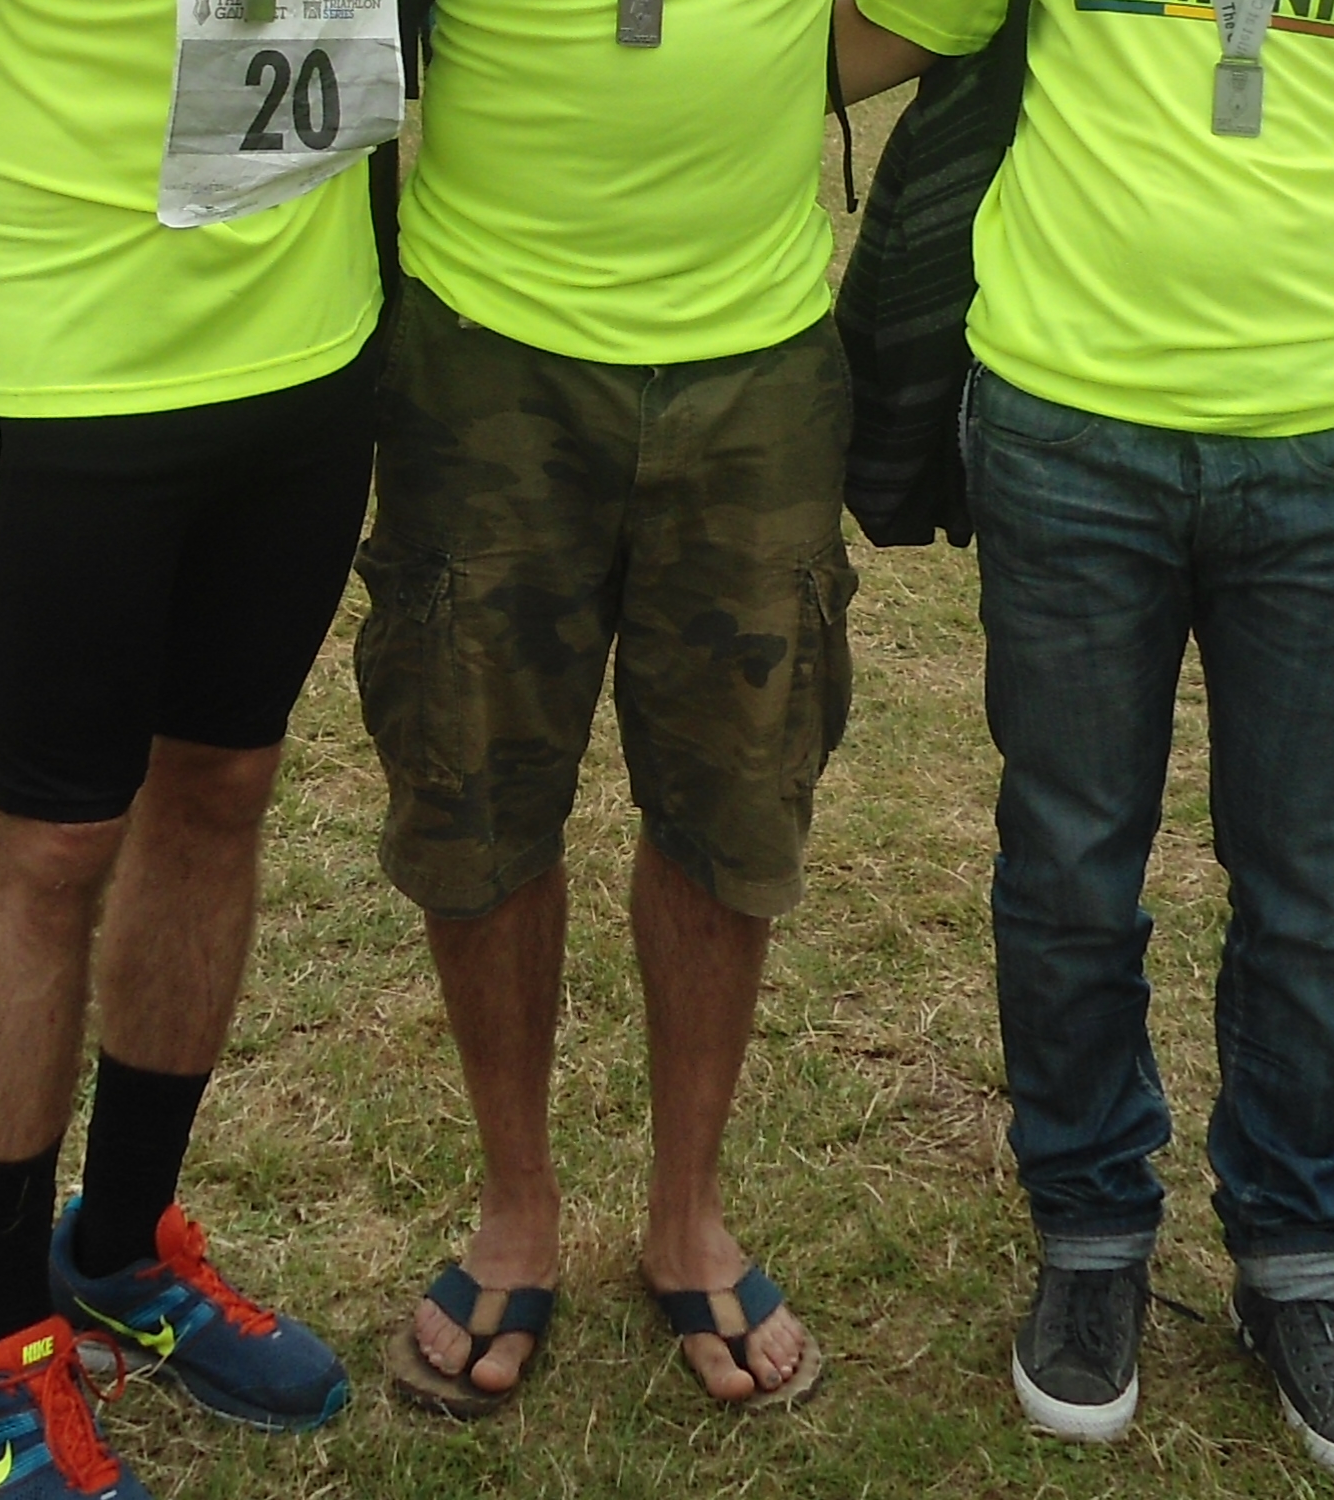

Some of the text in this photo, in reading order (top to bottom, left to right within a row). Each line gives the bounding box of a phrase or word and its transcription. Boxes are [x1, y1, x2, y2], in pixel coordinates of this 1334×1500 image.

[323, 0, 381, 9] TRIATHLON
[323, 9, 354, 20] SERIES
[1221, 1, 1237, 30] The
[239, 48, 340, 151] 20
[22, 1335, 55, 1366] NIKE
